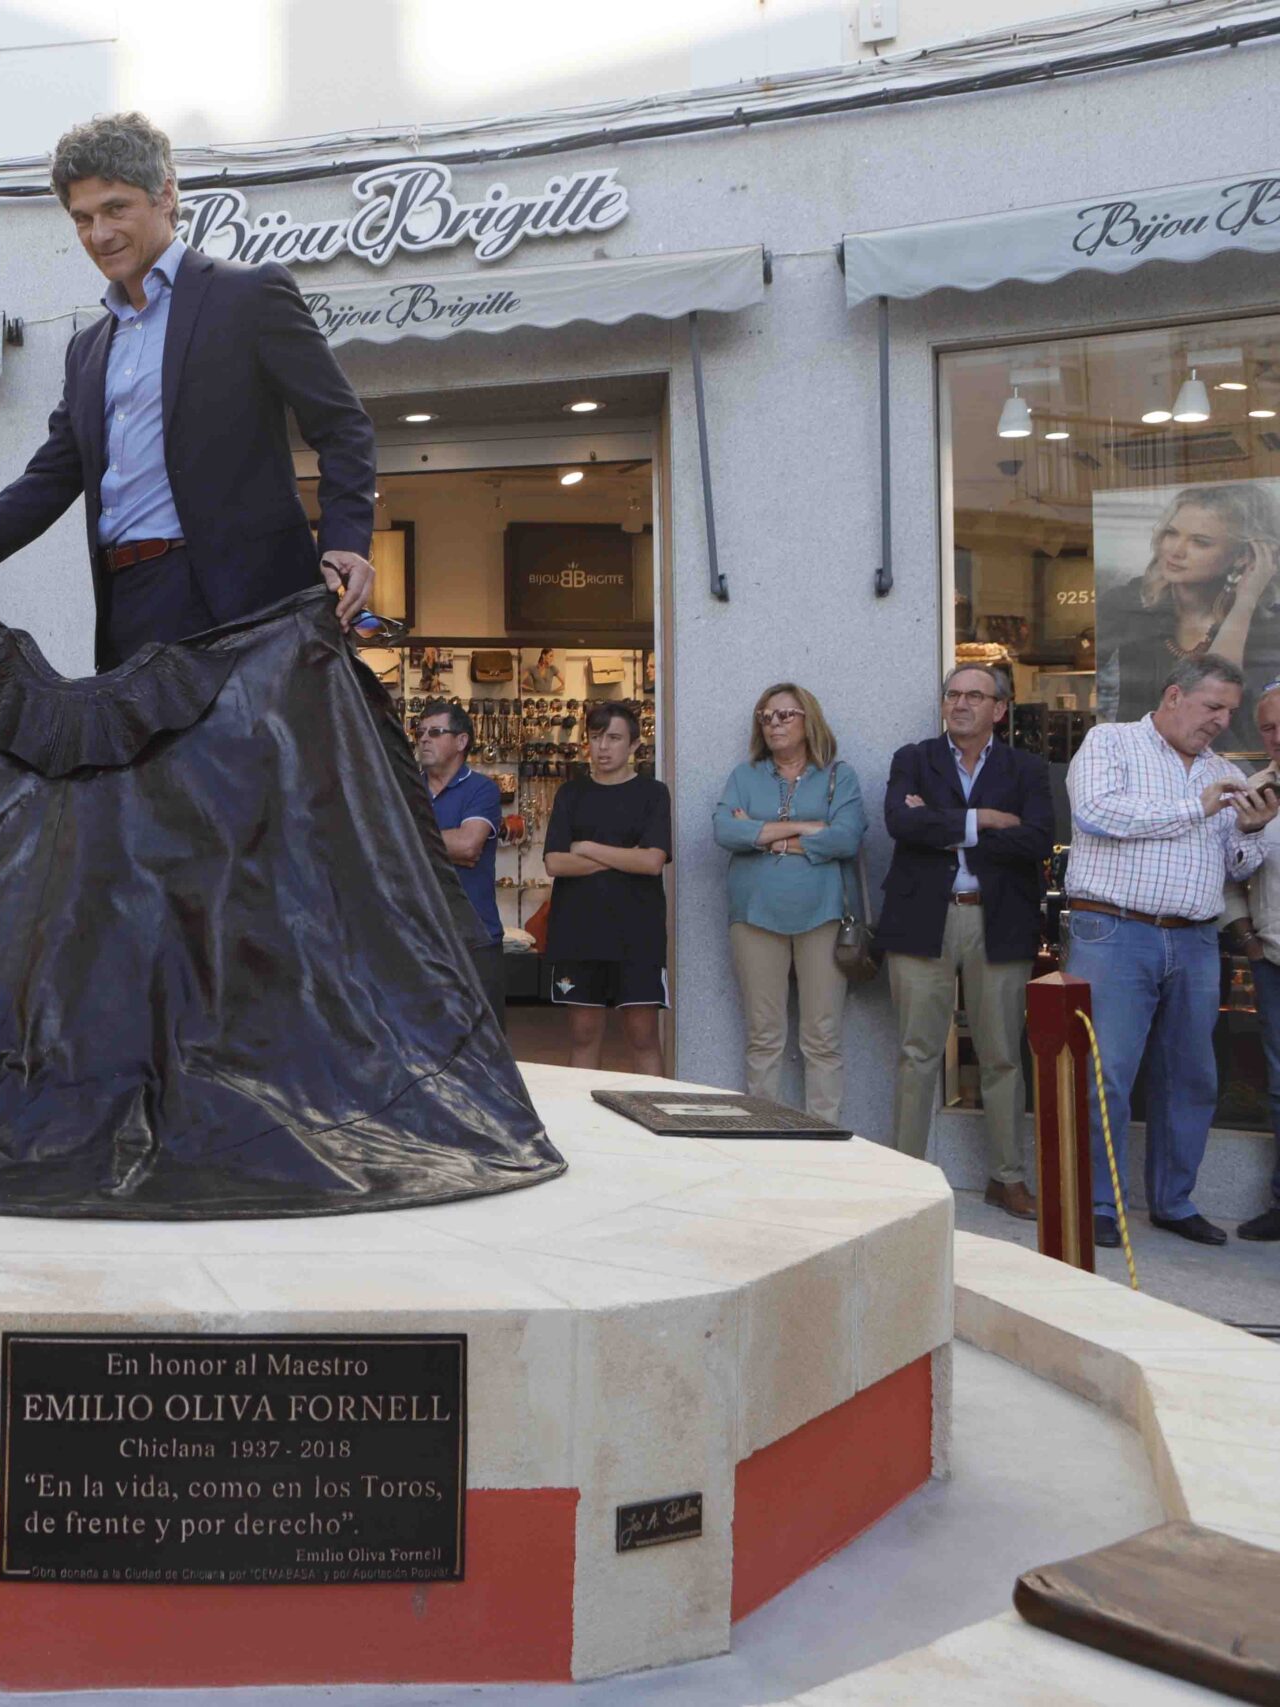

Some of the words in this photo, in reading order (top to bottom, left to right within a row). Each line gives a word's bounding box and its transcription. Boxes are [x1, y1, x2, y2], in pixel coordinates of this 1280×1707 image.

[176, 191, 344, 265] Bijou
[347, 167, 625, 258] Brigitte
[1072, 201, 1210, 257] Bijou
[385, 284, 521, 329] Brigitte
[107, 1353, 139, 1376] En
[149, 1353, 228, 1376] honor
[234, 1353, 257, 1376] al
[267, 1353, 369, 1376] Maestro
[23, 1394, 154, 1421] EMILIO
[165, 1394, 277, 1421] OLIVA
[288, 1394, 452, 1421] FORNELL
[119, 1438, 216, 1458] Chiclana
[230, 1440, 281, 1459] 1937
[300, 1440, 352, 1459] 2018
[83, 1474, 104, 1498] la
[116, 1474, 179, 1502] vida,
[188, 1480, 262, 1499] como
[271, 1480, 302, 1499] en
[314, 1475, 351, 1499] los
[360, 1475, 443, 1502] Toros,
[24, 1510, 56, 1534] de
[65, 1510, 146, 1535] frente
[154, 1517, 171, 1544] y
[180, 1516, 226, 1544] por
[295, 1547, 344, 1563] Emilio
[347, 1547, 386, 1563] Oliva
[389, 1546, 442, 1562] Fornell
[32, 1565, 57, 1579] Obra
[60, 1567, 99, 1580] donada
[111, 1567, 121, 1580] la
[124, 1567, 162, 1581] Ciudad
[165, 1567, 179, 1581] de
[229, 1570, 248, 1583] por
[333, 1569, 351, 1582] por
